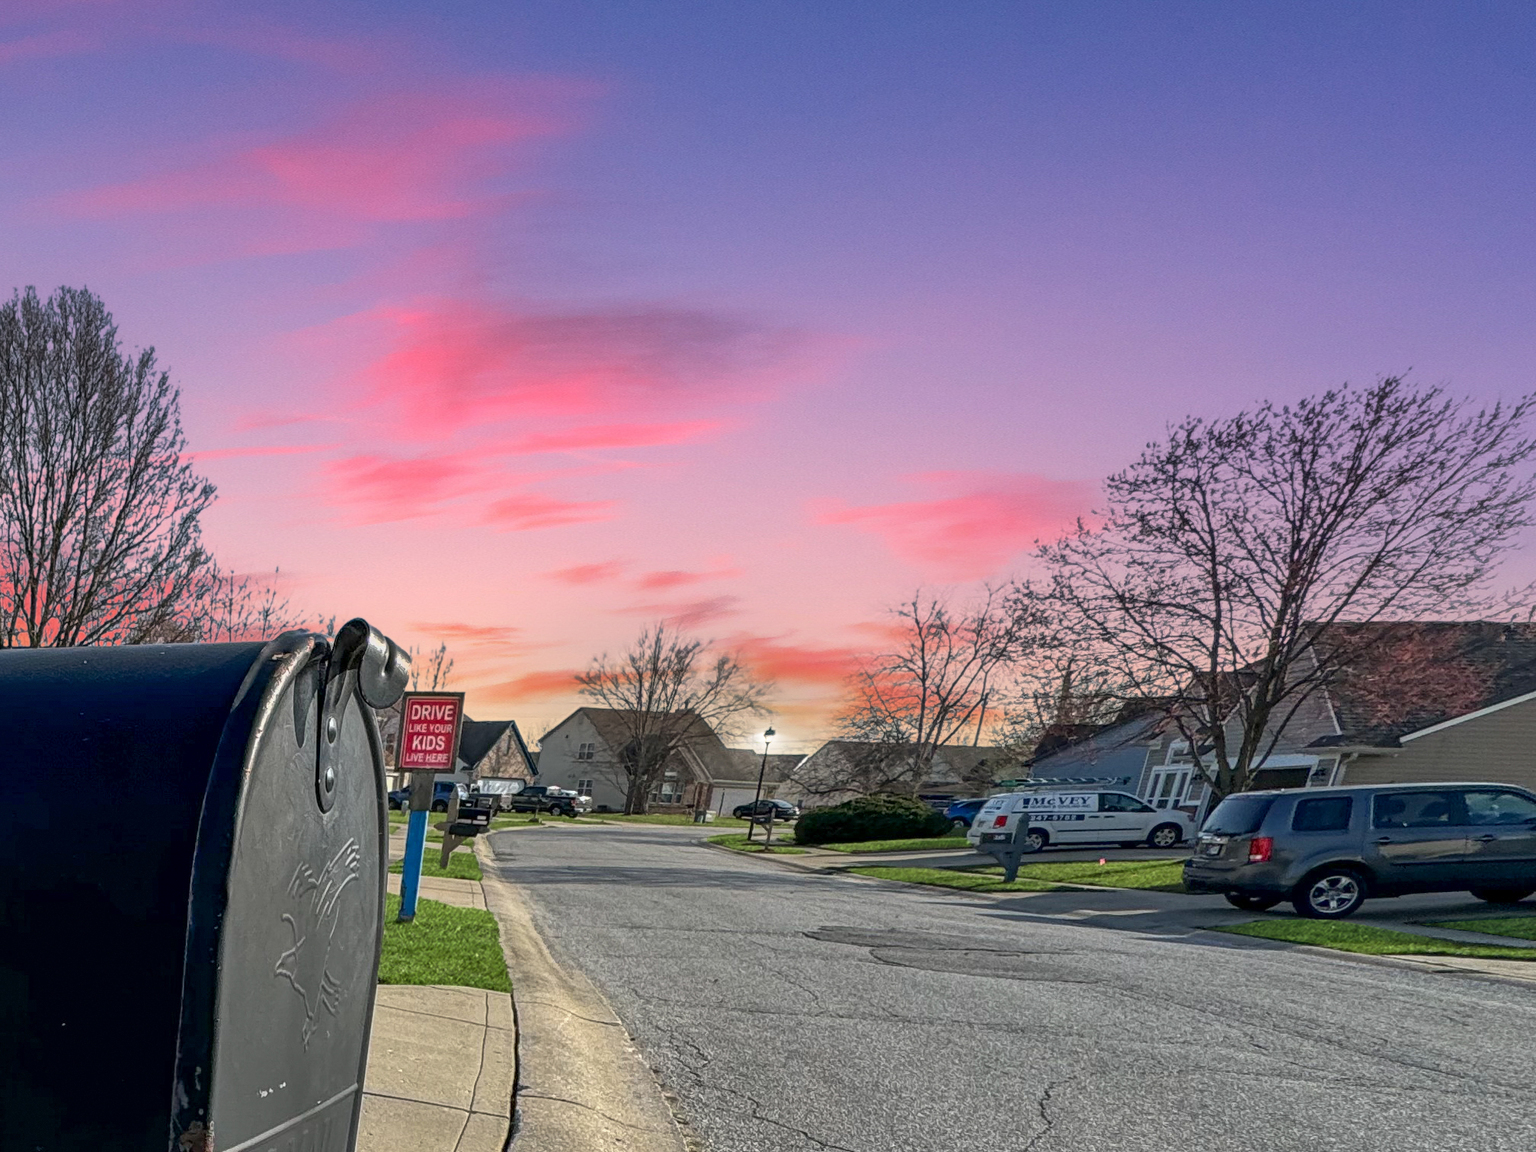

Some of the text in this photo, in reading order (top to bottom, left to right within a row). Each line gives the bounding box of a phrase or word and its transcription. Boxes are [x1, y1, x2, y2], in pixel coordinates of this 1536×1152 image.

[411, 705, 455, 720] DRIVE
[409, 723, 453, 733] LIKE YOUR
[411, 735, 446, 751] KIDS
[406, 752, 449, 763] LIVE HERE
[1031, 796, 1091, 805] McVEY
